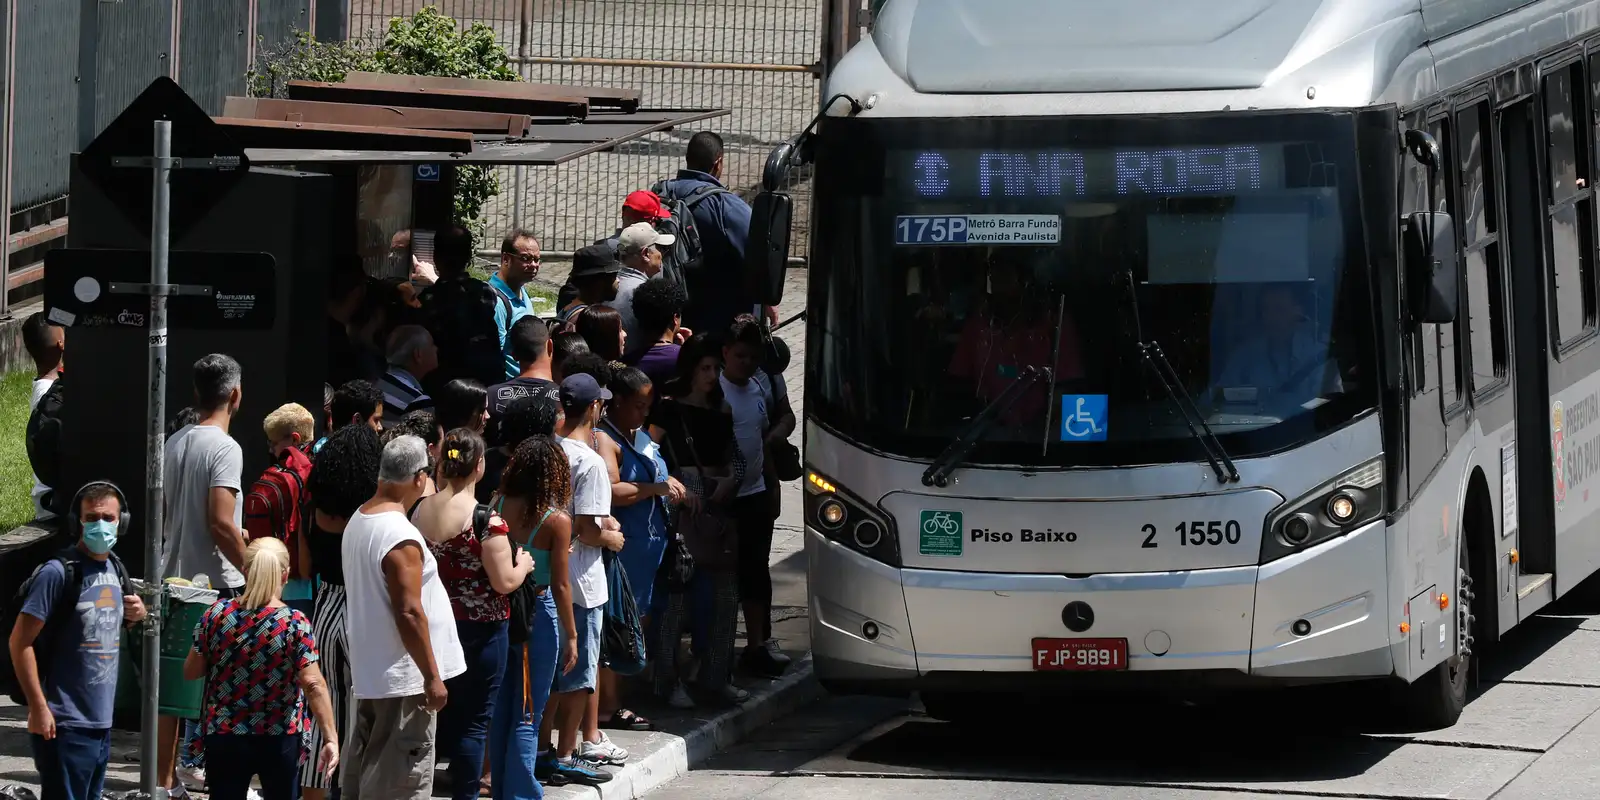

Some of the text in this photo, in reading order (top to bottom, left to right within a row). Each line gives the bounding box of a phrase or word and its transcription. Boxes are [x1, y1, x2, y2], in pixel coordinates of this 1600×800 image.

[980, 146, 1260, 196] ANA ROSA
[898, 217, 967, 243] 175P
[967, 232, 1057, 241] Avenida Paulista
[968, 219, 1058, 229] Metrô Barra Funda
[1566, 390, 1600, 438] PREFEITURA
[1584, 432, 1600, 479] PAU
[970, 528, 1014, 543] Piso
[1020, 528, 1078, 543] Baixo
[1141, 520, 1241, 549] 2 1550
